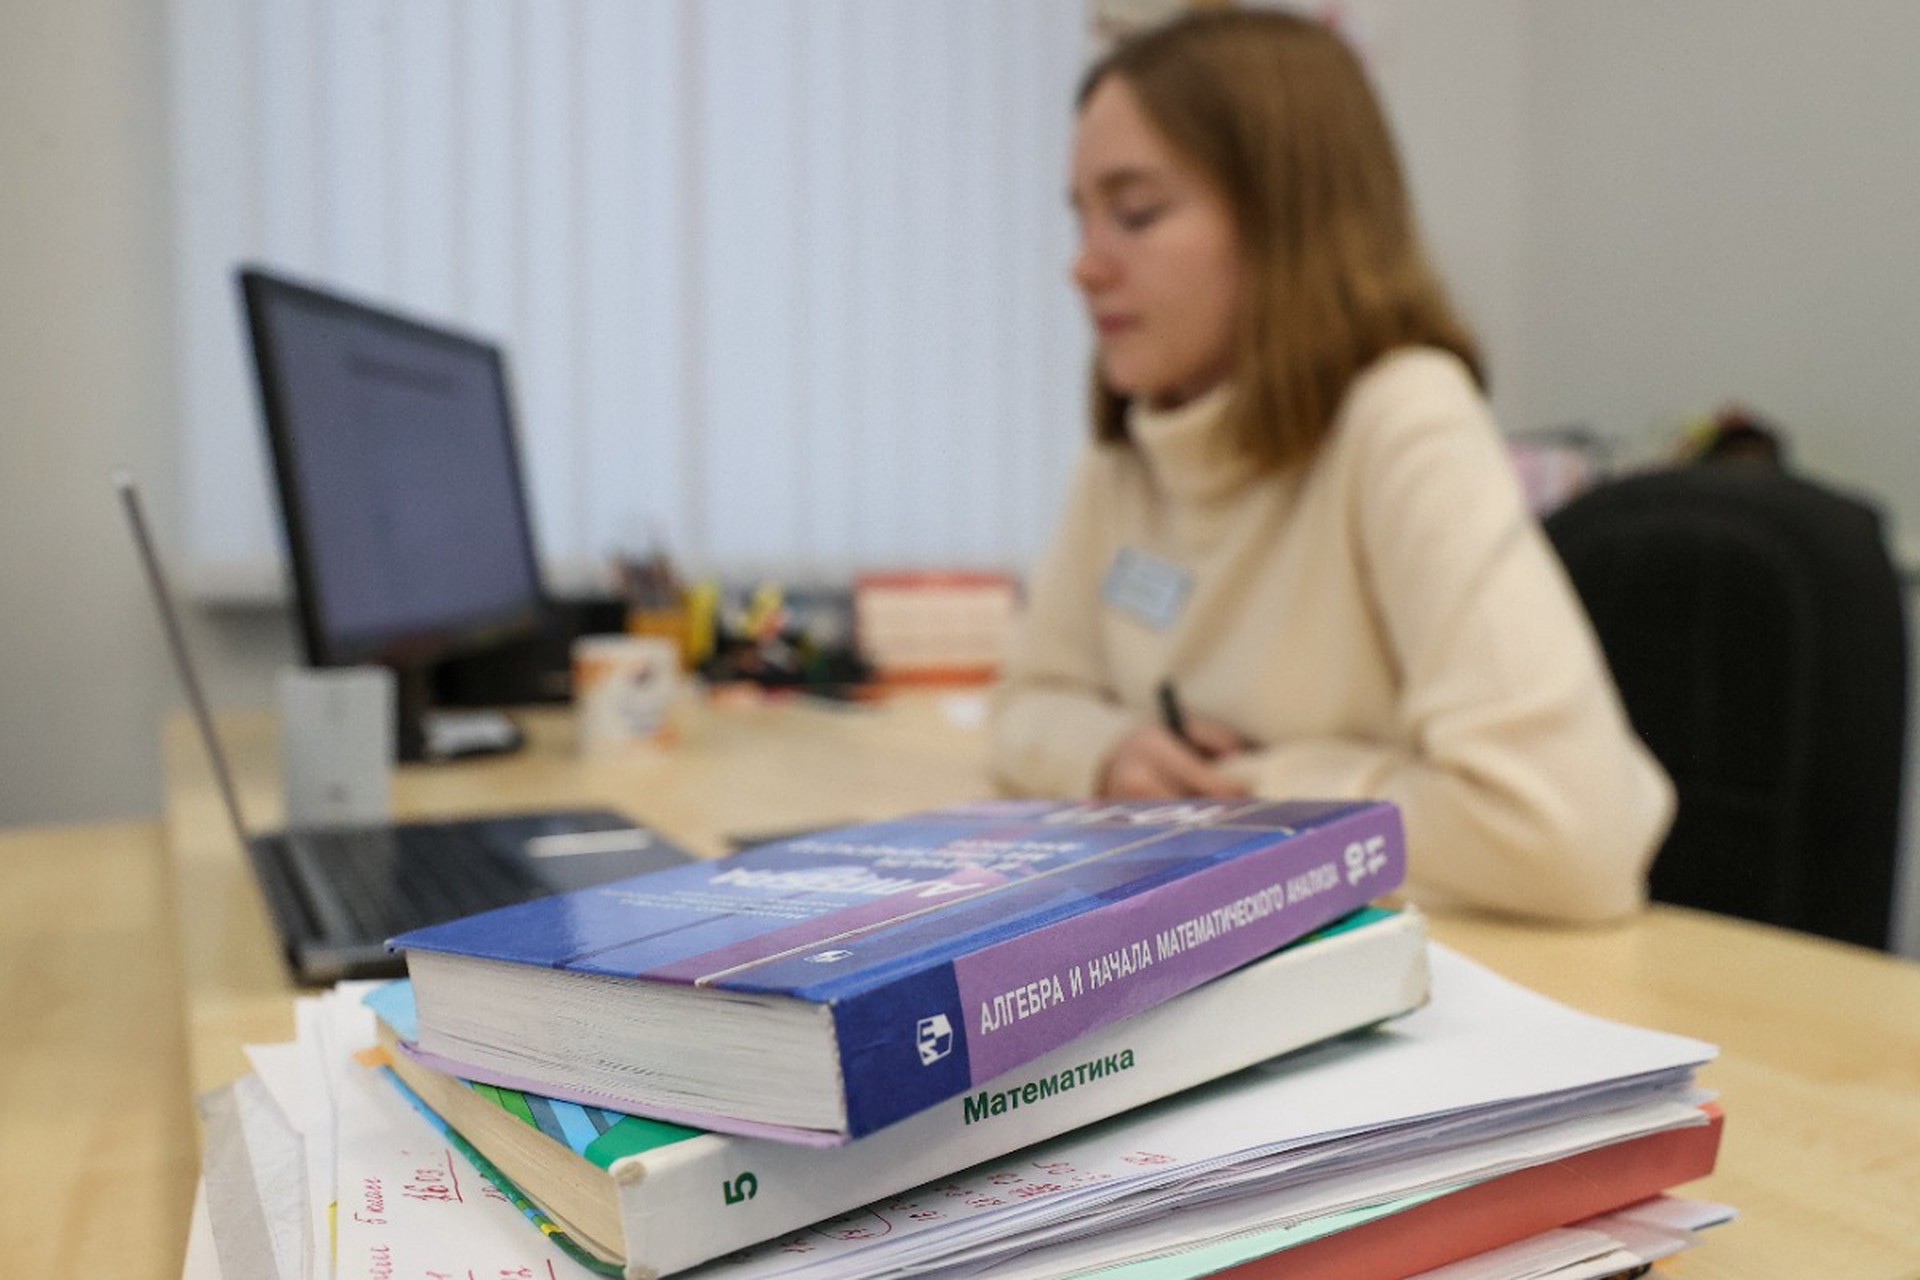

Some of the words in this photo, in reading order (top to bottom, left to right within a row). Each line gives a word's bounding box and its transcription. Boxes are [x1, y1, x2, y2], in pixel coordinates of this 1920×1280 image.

[979, 977, 1065, 1035] АЛГЕБРА
[1068, 965, 1084, 996] И
[1087, 943, 1153, 991] НАЧАЛА
[1156, 885, 1285, 961] МАТЕМАТИЧЕСКОГО
[1287, 862, 1340, 905] АНАЛИЗА
[962, 1048, 1136, 1125] Математика
[722, 1171, 759, 1206] 5
